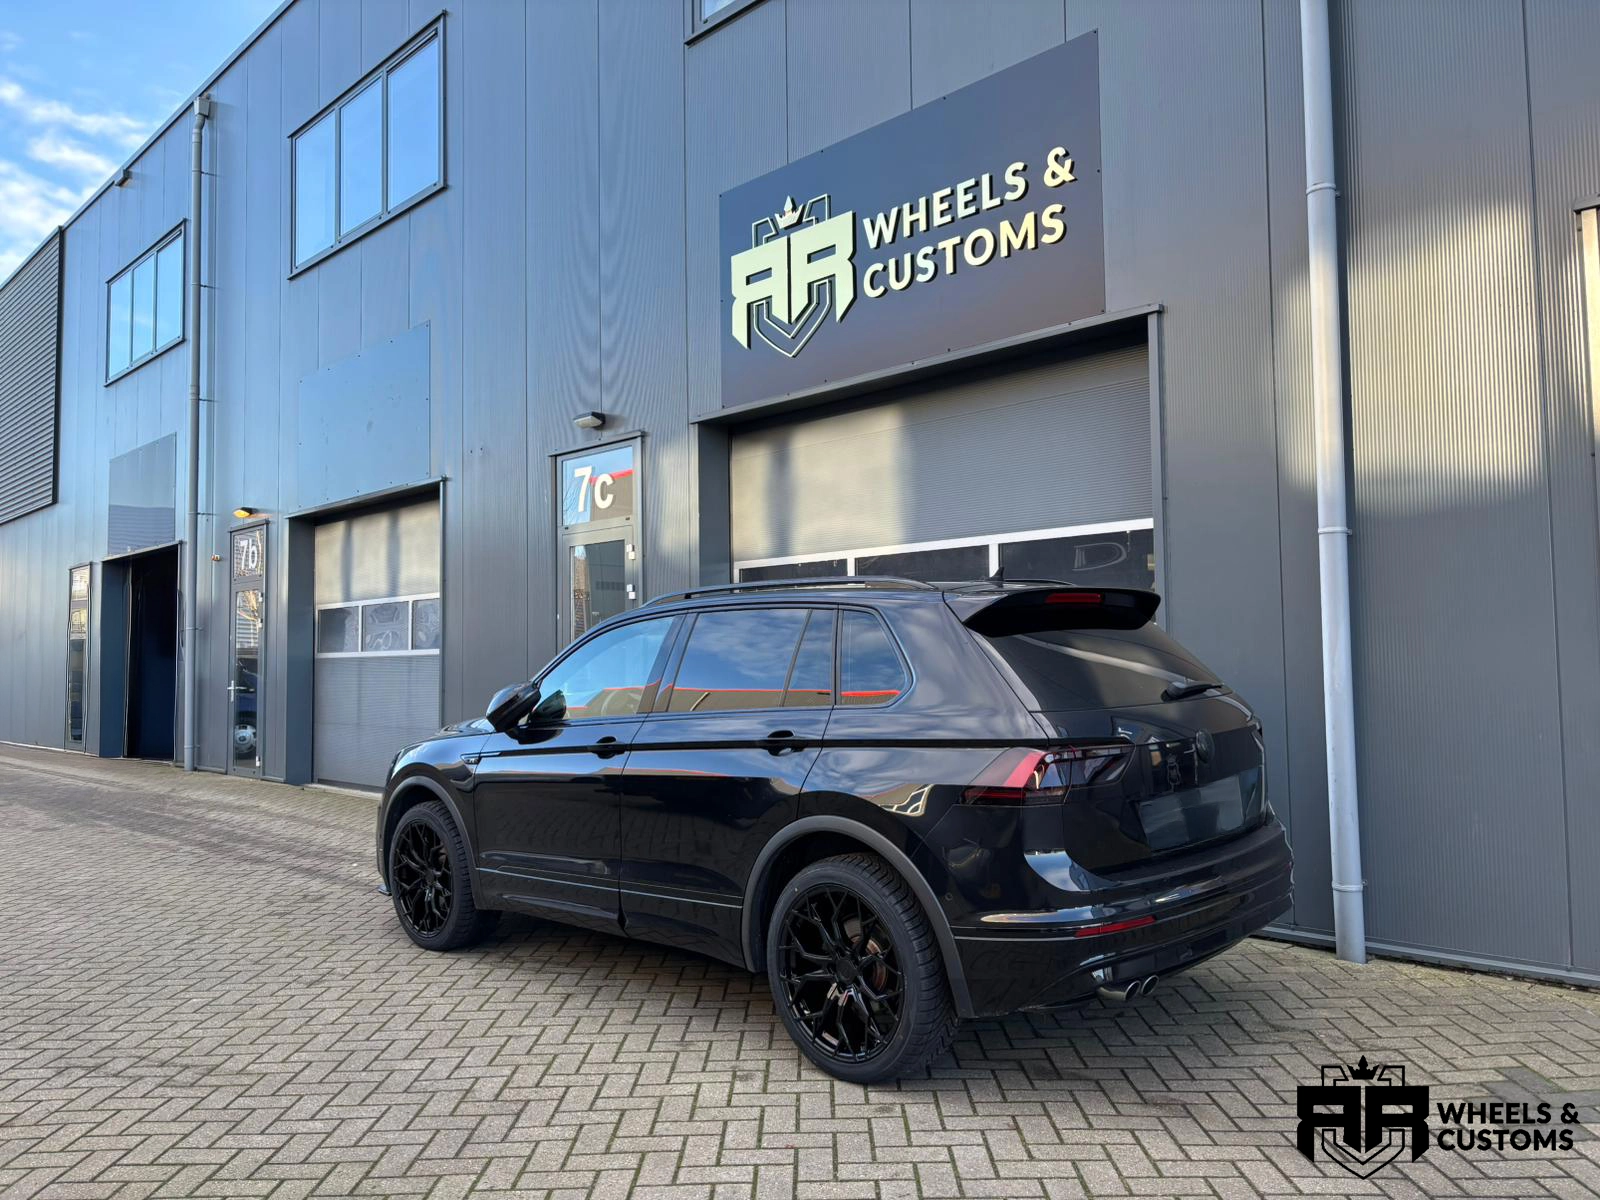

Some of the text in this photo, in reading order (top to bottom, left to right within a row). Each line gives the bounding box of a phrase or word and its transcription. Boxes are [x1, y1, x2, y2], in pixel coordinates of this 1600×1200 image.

[863, 146, 1076, 249] WHEELS &
[863, 203, 1065, 298] CUSTOMS
[240, 538, 258, 570] 7b
